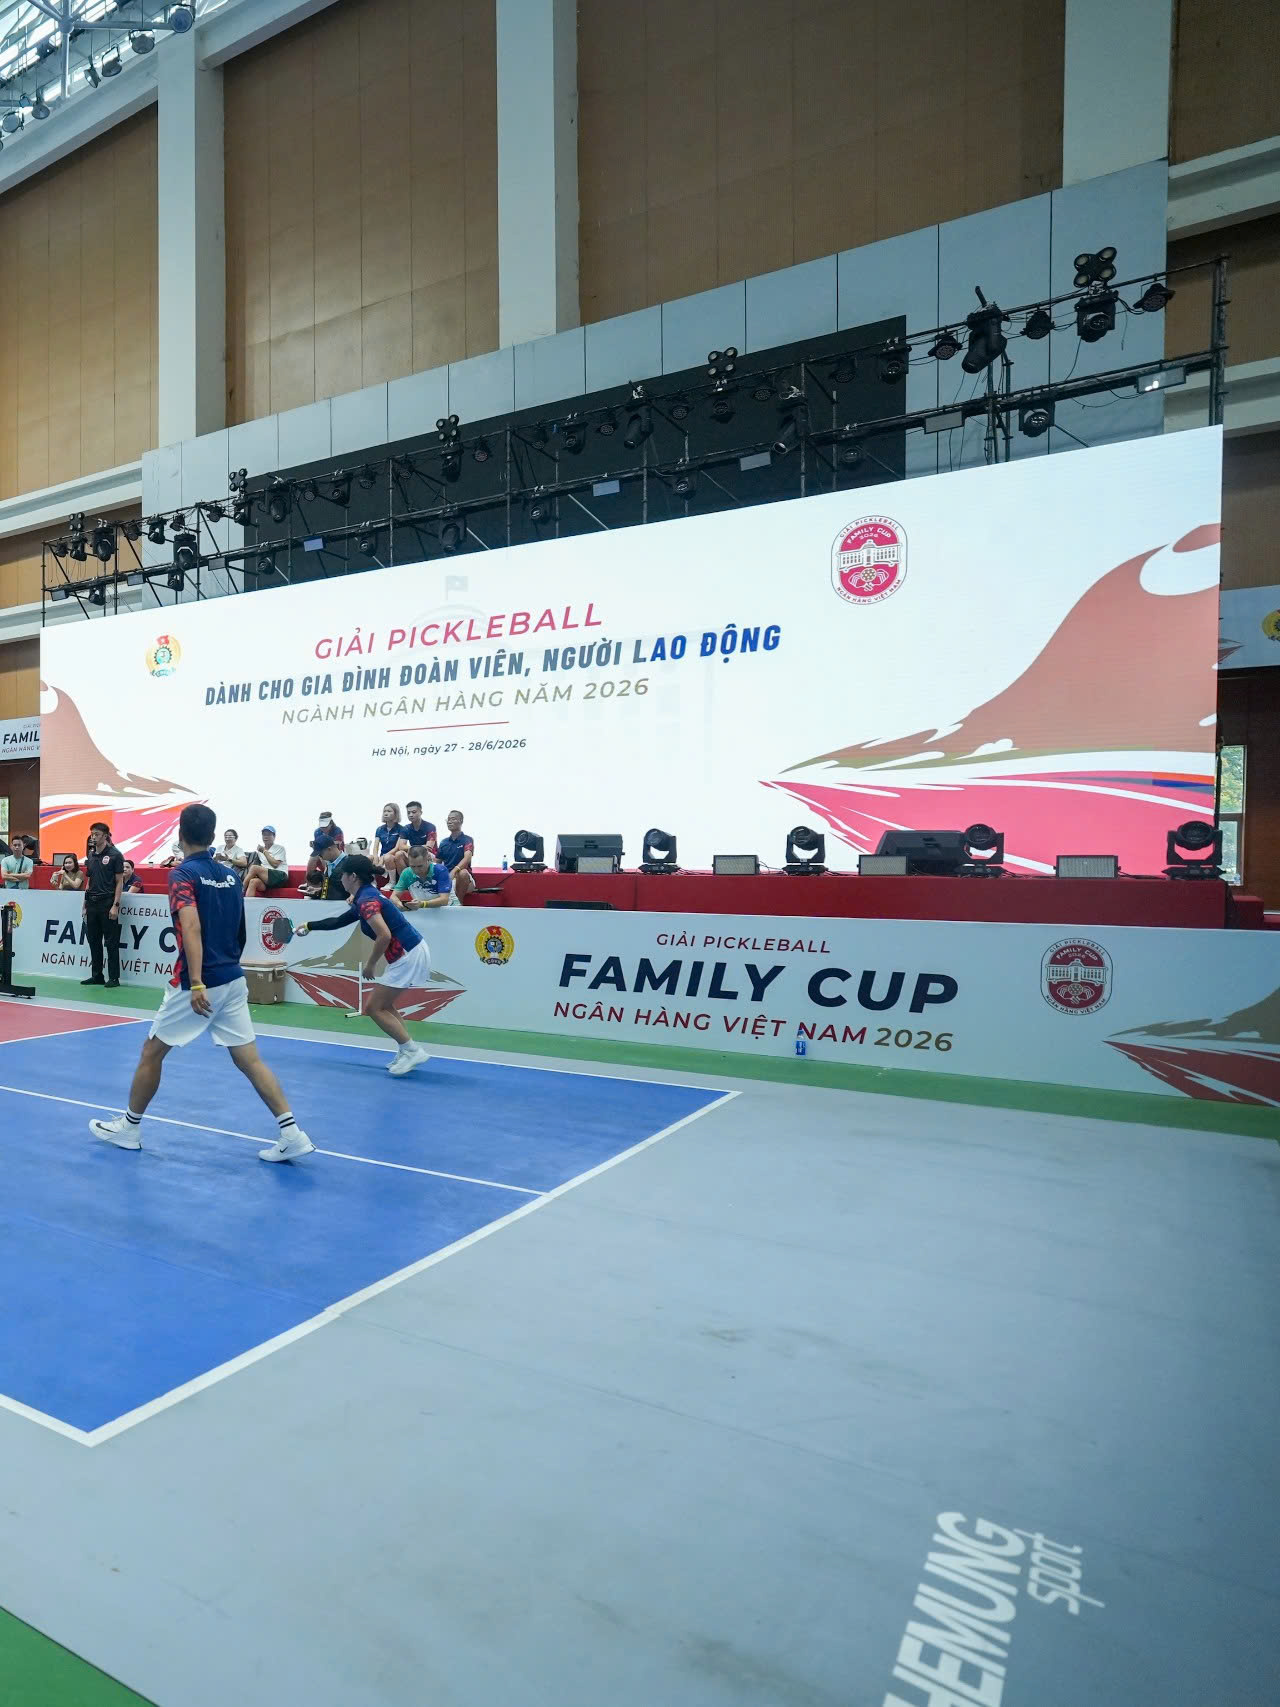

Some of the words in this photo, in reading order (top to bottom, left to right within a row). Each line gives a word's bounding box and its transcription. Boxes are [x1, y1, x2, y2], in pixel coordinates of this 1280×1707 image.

[314, 627, 375, 659] GIẢI
[387, 603, 602, 651] PICKLEBALL
[205, 681, 251, 706] DÀNH
[258, 678, 294, 700] CHO
[301, 673, 333, 697] GIA
[342, 665, 391, 692] ĐÌNH
[399, 656, 459, 687] ĐOÀN
[469, 649, 531, 680] VIÊN,
[542, 637, 622, 672] NGƯỜI
[632, 635, 688, 663] LAO
[699, 623, 781, 664] ĐỘNG
[282, 704, 355, 725] NGÀNH
[363, 695, 426, 718] NGÂN
[435, 690, 504, 711] HÀNG
[514, 683, 573, 705] NĂM
[583, 678, 650, 700] 2026
[3, 731, 40, 744] FAMIL
[372, 746, 386, 756] Hà
[413, 745, 441, 756] ngày
[444, 743, 458, 753] 27
[468, 738, 527, 751] 28/6/2026
[118, 906, 169, 917] ICKLEBALL
[41, 952, 75, 966] NGÂN
[656, 930, 696, 947] GIẢI
[703, 935, 831, 953] PICKLEBALL
[121, 958, 150, 976] VIỆT
[559, 953, 786, 1002] FAMILY
[807, 967, 959, 1013] CUP
[553, 1001, 625, 1023] NGÂN
[634, 1006, 712, 1031] HÀNG
[723, 1014, 787, 1040] VIỆT
[797, 1021, 867, 1045] NAM
[873, 1027, 954, 1052] 2026
[1014, 1528, 1106, 1615] sport
